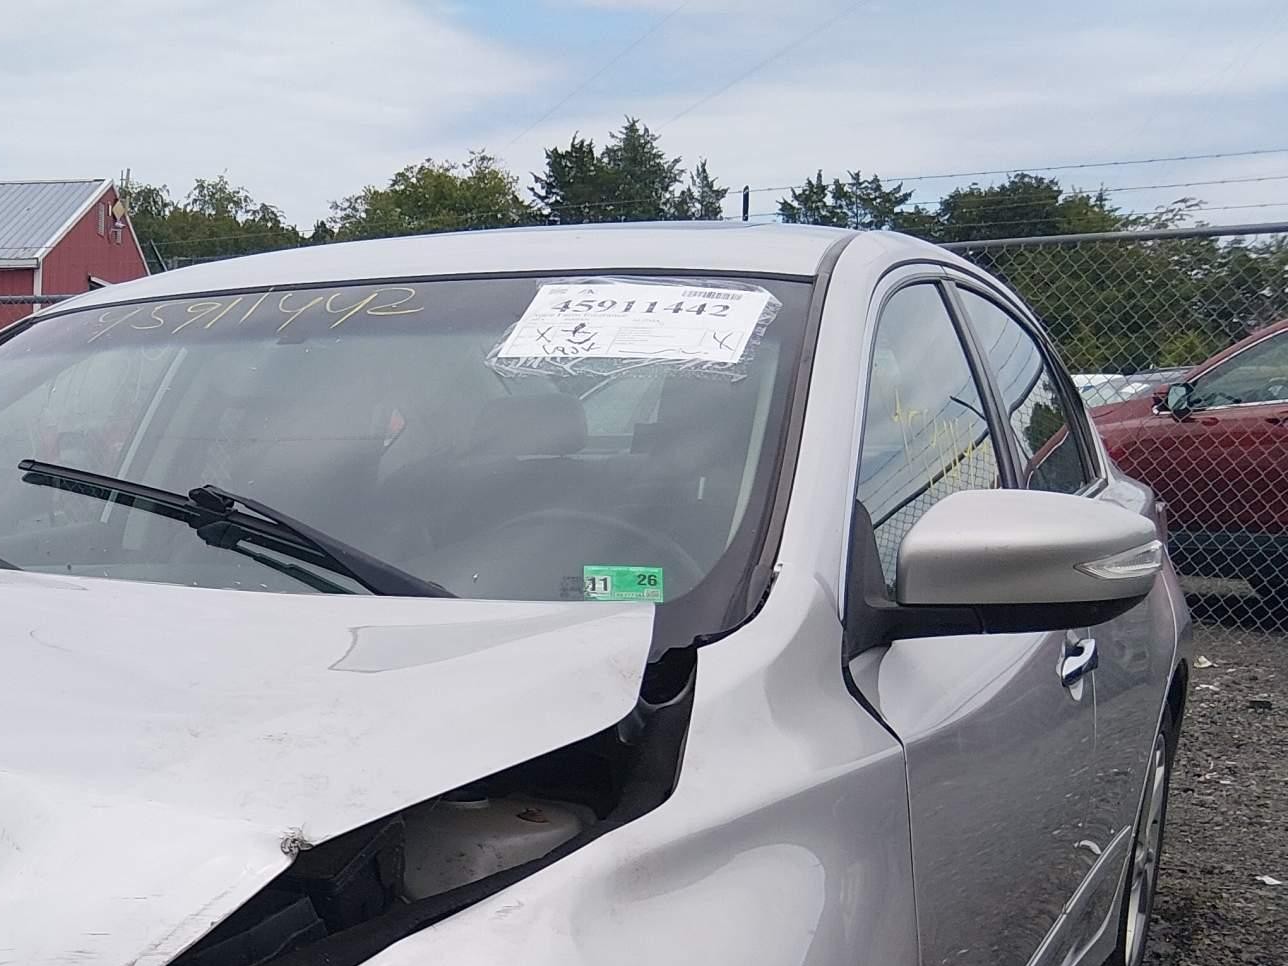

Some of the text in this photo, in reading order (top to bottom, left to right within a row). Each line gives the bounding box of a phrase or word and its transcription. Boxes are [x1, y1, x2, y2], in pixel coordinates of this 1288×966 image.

[87, 287, 425, 344] 45911442
[550, 298, 732, 318] 45911442
[587, 576, 609, 592] 11
[637, 573, 658, 587] 26
